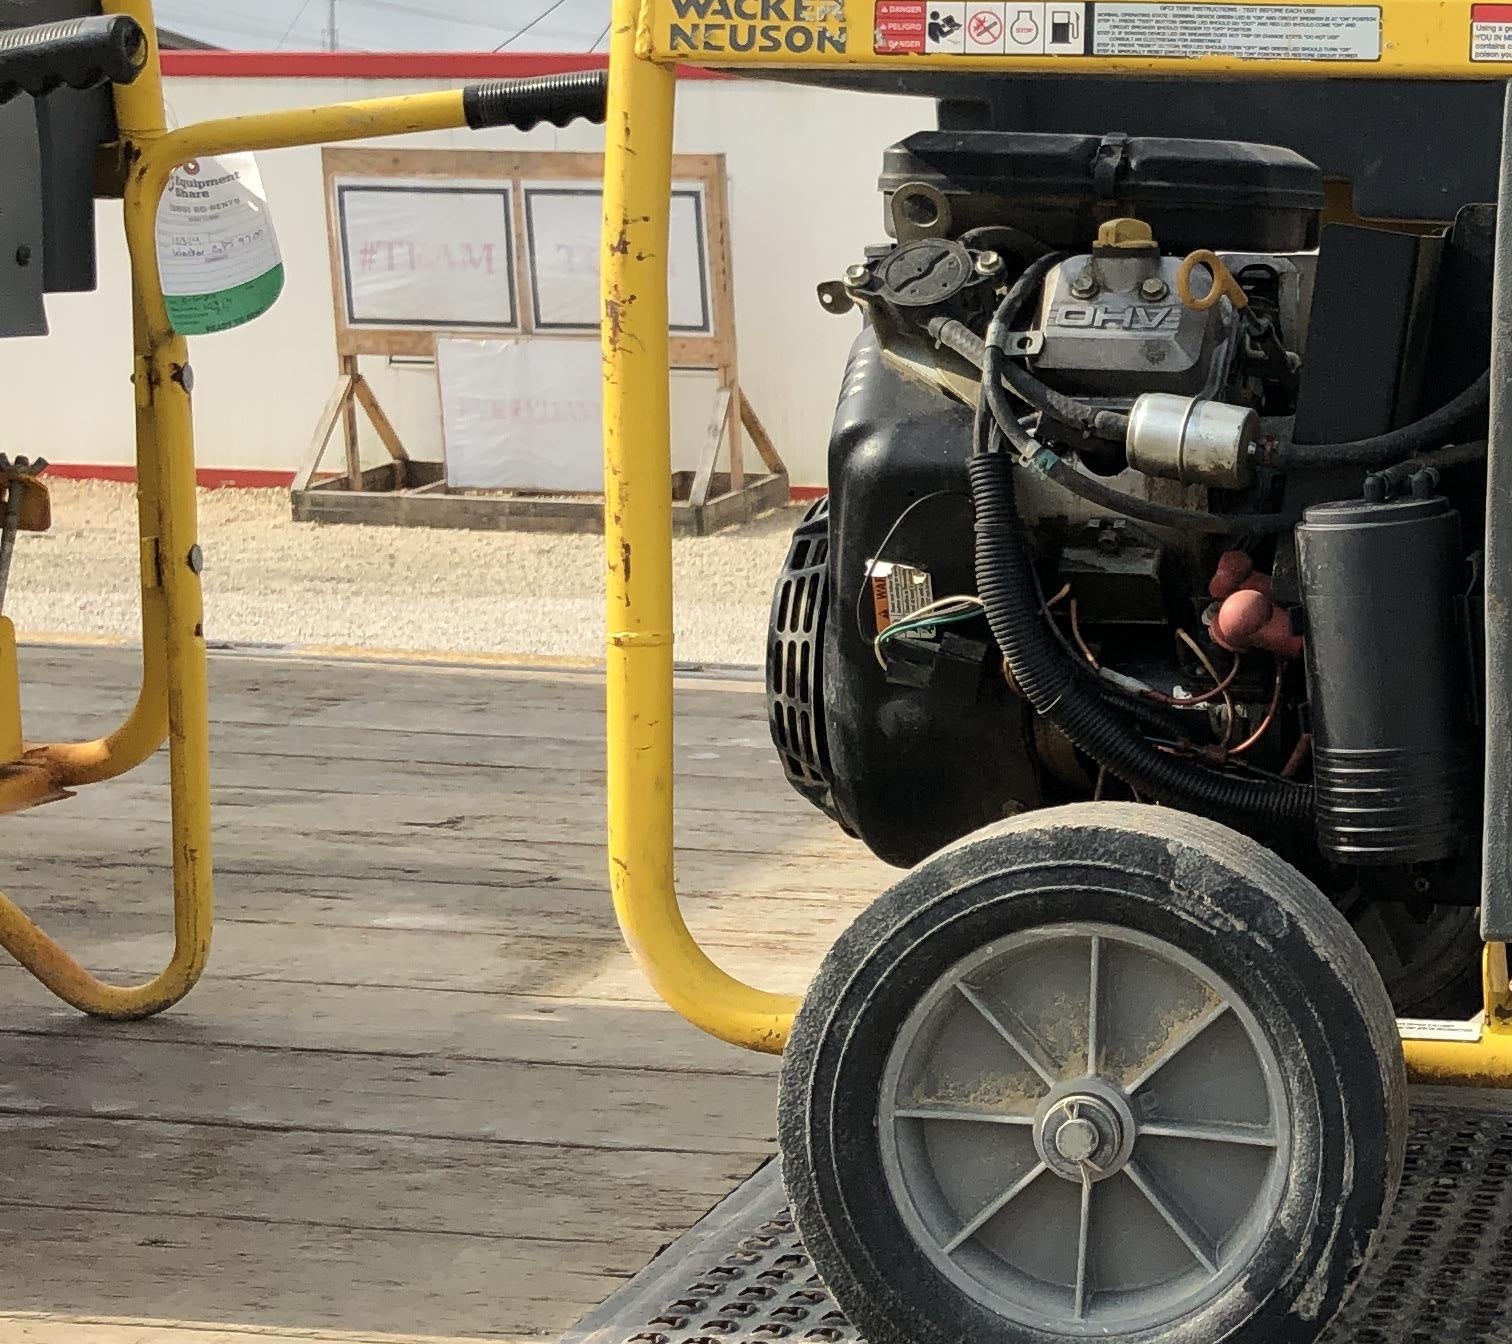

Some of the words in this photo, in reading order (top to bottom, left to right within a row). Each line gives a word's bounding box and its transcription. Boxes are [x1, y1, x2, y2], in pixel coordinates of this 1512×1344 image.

[888, 23, 922, 31] PELIGRO
[1476, 25, 1496, 33] Using
[669, 23, 847, 53] NEUSON
[1475, 34, 1492, 42] YOU
[175, 171, 240, 189] Equipment
[175, 187, 210, 198] Share
